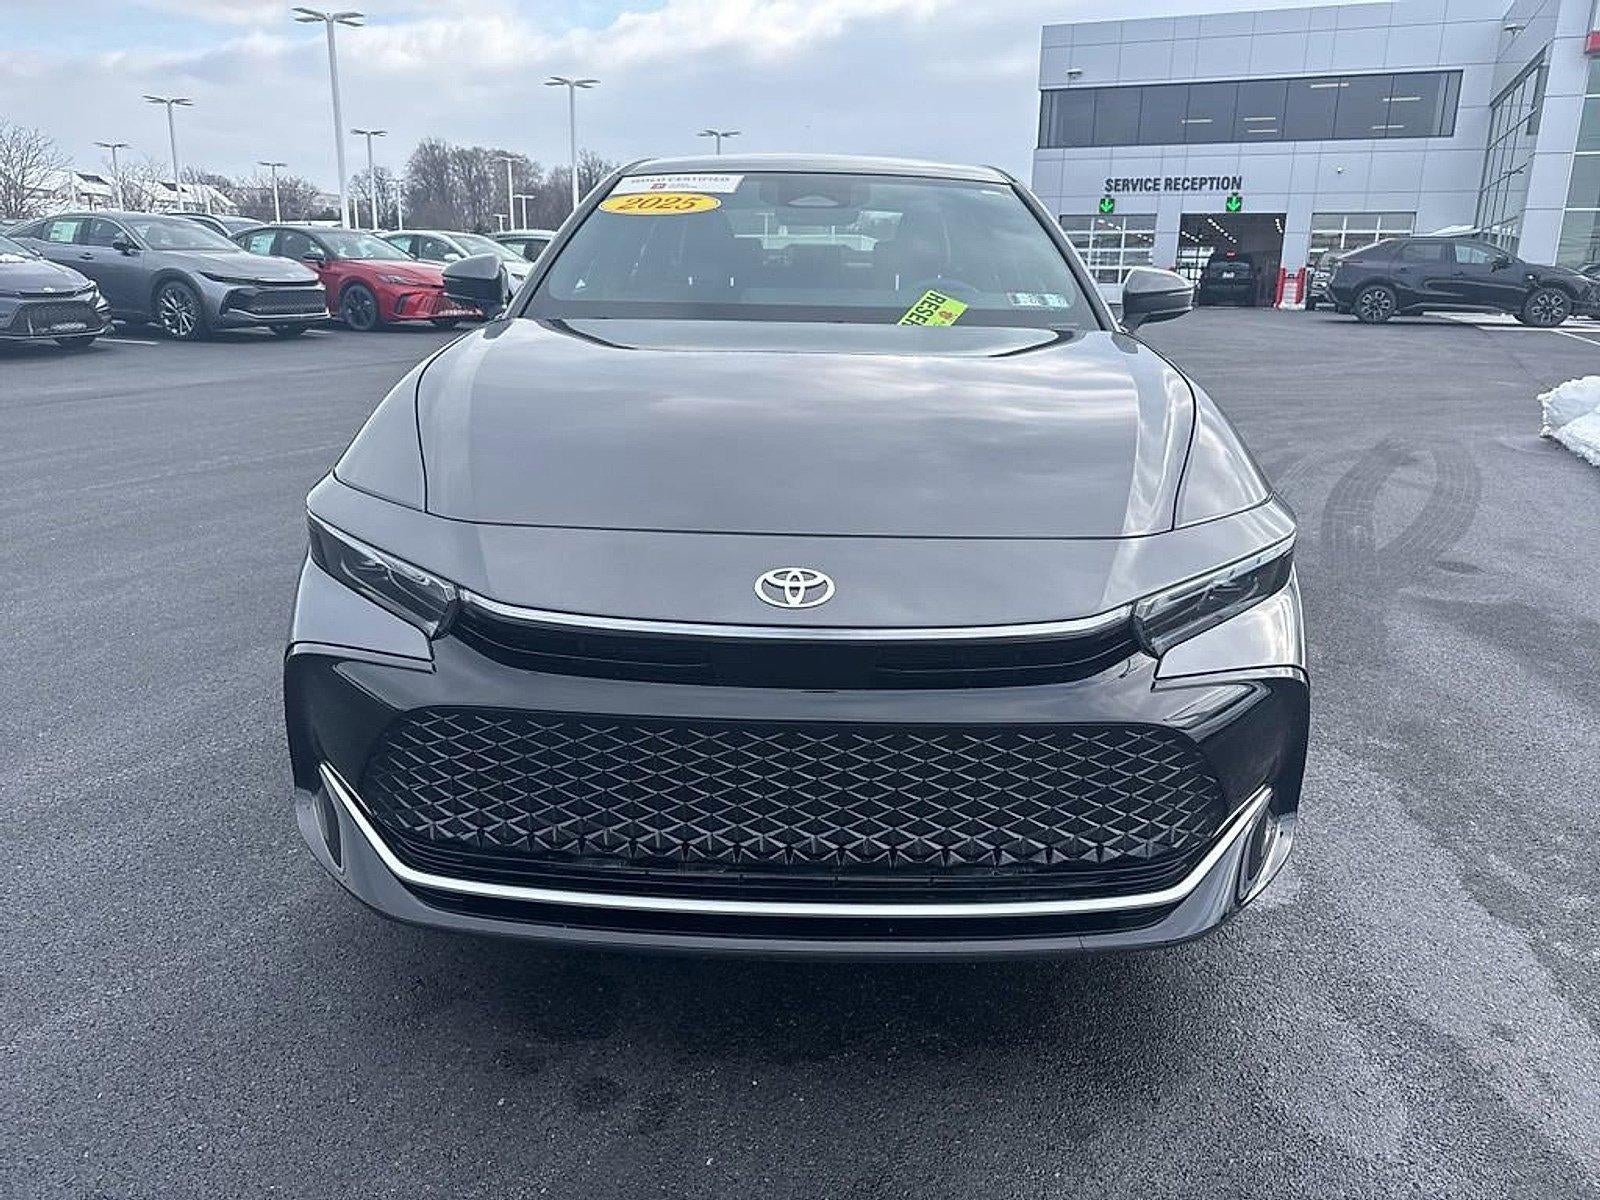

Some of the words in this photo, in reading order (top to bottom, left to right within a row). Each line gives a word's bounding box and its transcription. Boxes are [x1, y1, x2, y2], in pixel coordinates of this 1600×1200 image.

[1105, 178, 1161, 192] SERVICE
[1164, 176, 1242, 191] RECEPTION
[616, 197, 701, 210] 2025
